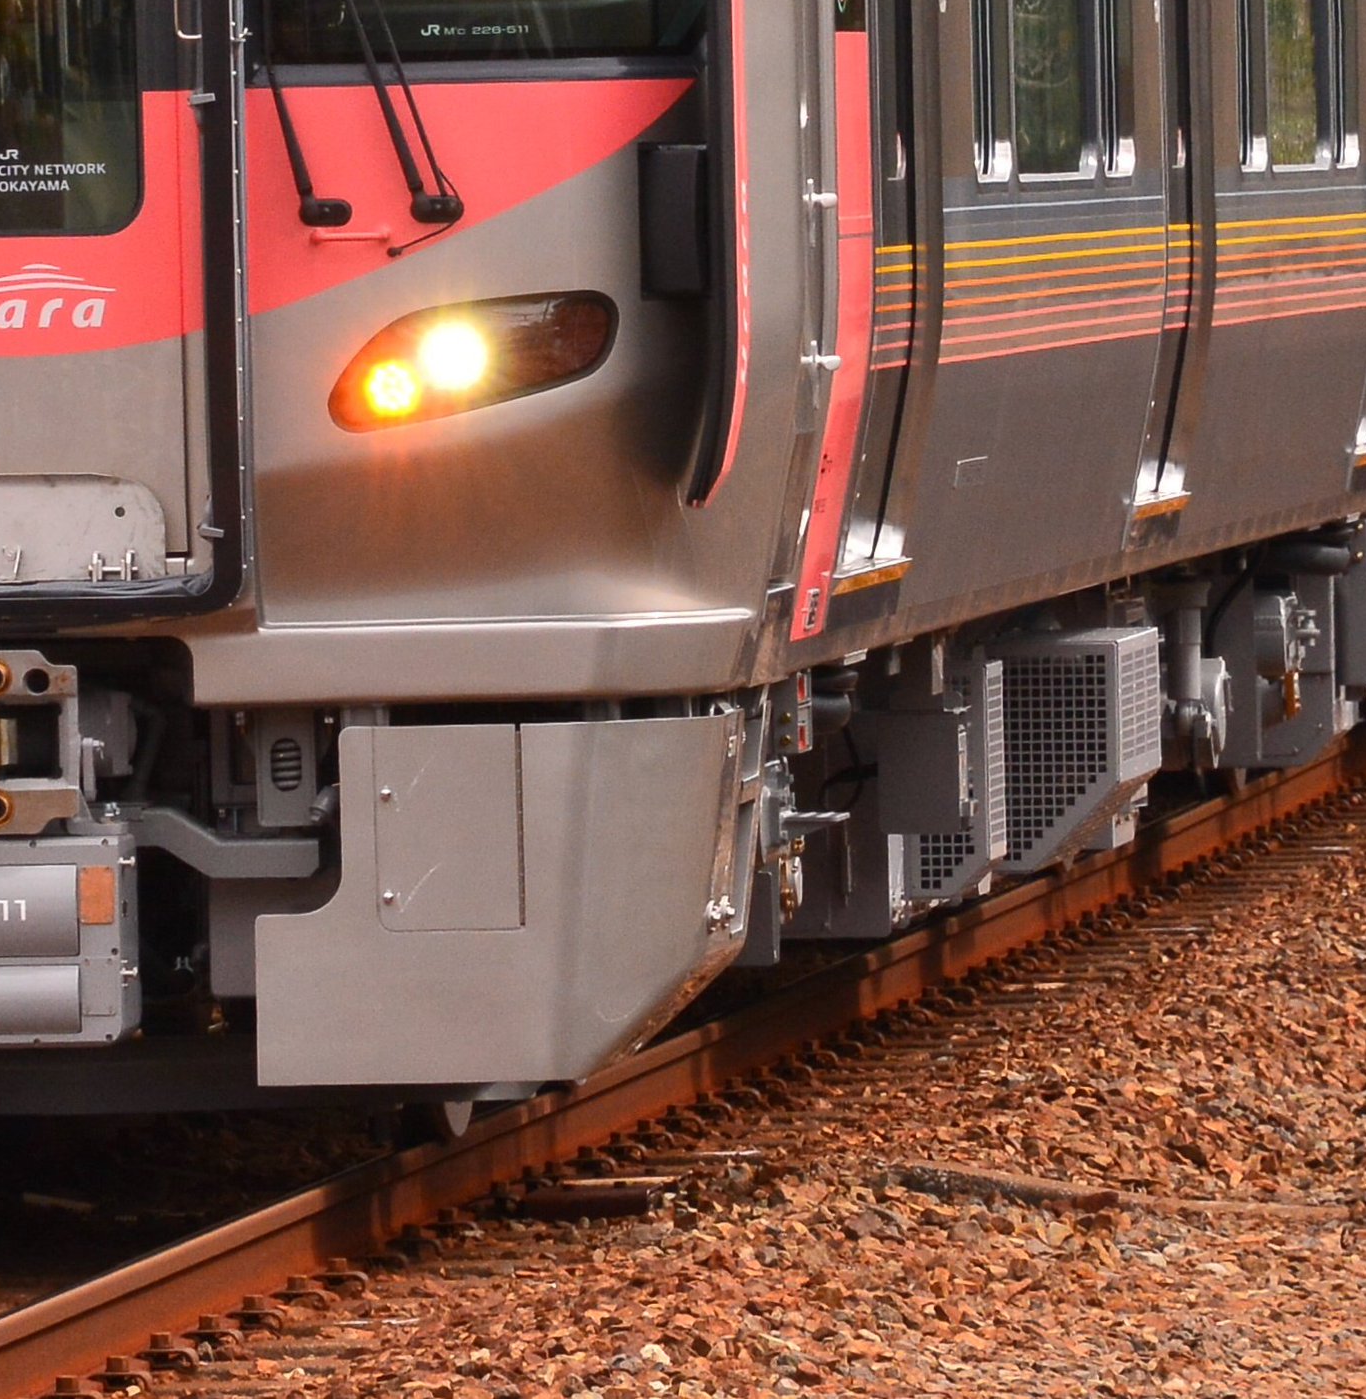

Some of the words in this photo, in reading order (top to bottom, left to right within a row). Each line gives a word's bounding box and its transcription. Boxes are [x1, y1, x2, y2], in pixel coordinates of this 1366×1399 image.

[420, 24, 440, 36] JR
[0, 149, 19, 160] JR
[34, 163, 107, 176] NETWORK
